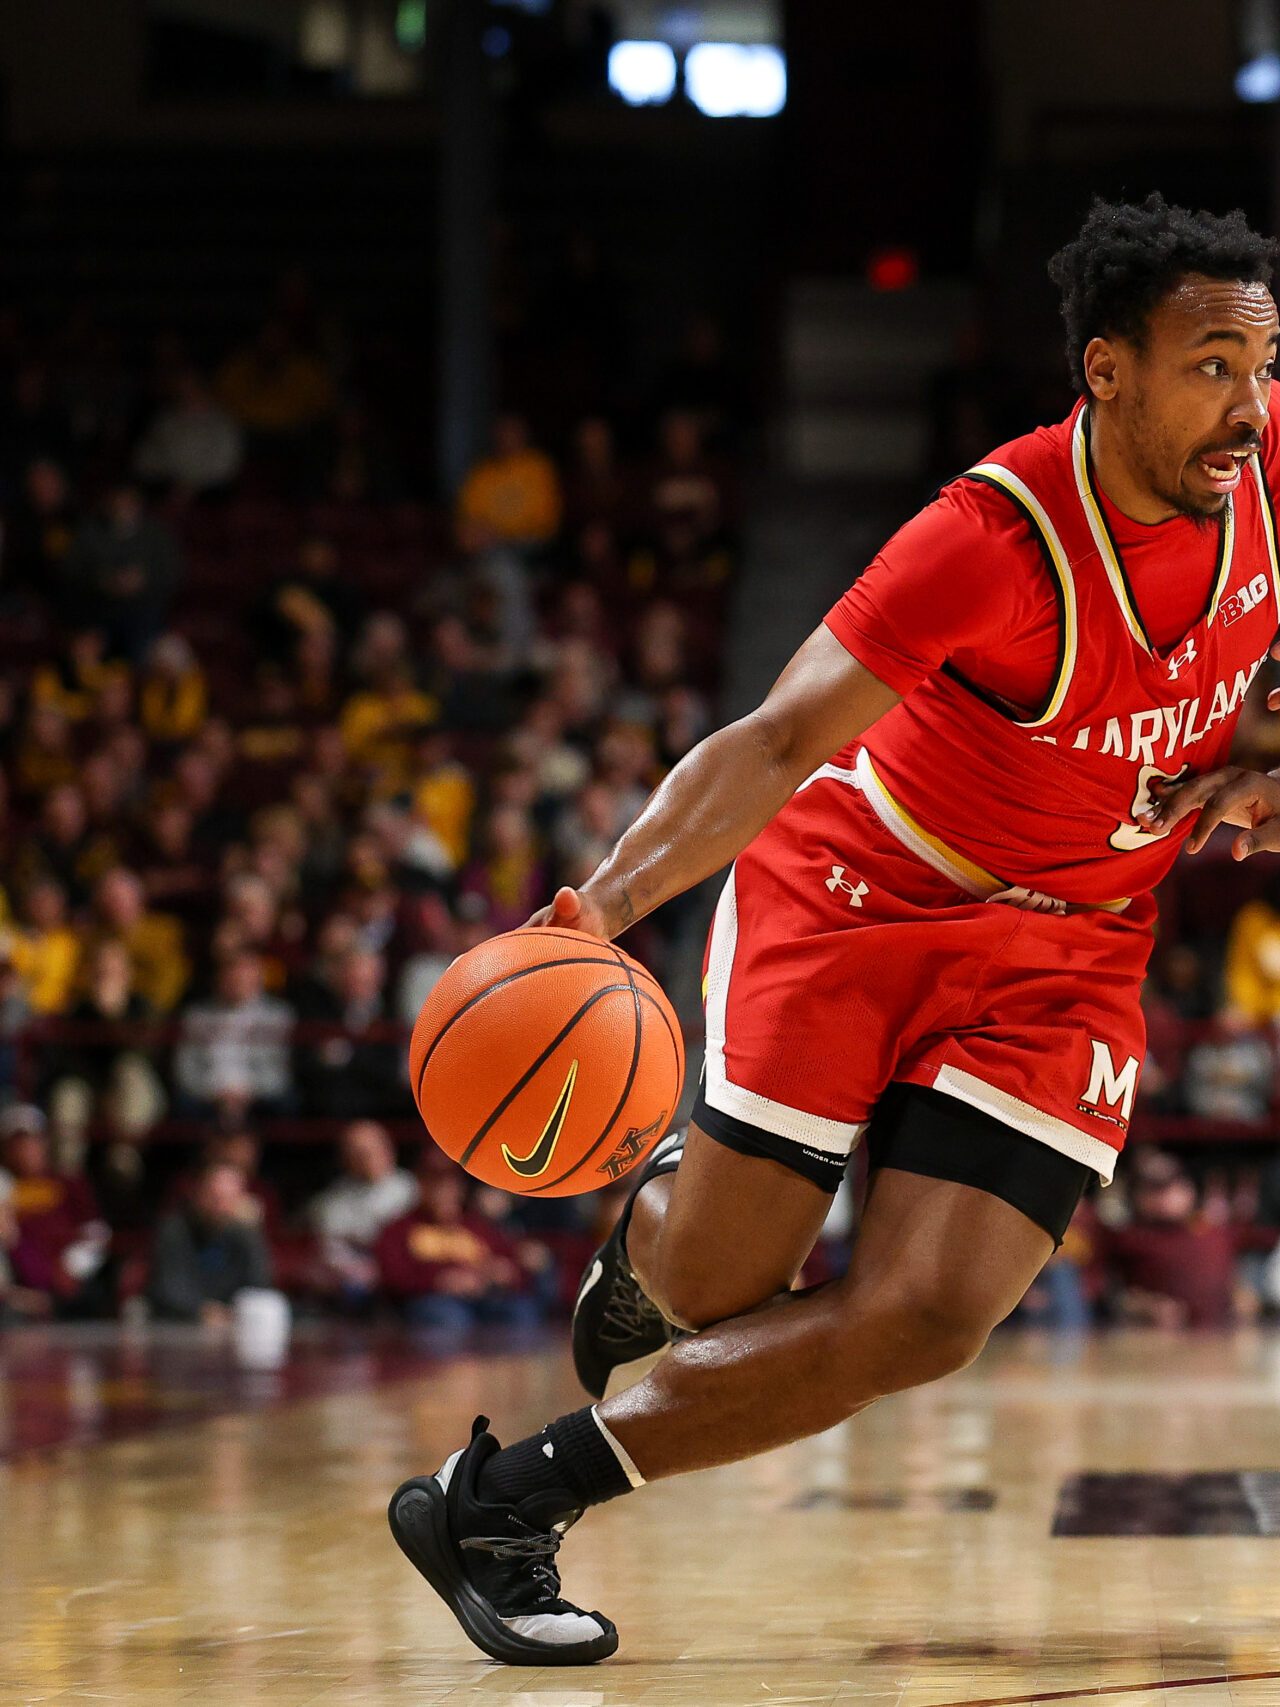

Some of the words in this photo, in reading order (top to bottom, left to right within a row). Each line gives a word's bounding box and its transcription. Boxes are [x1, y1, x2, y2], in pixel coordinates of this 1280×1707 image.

[1031, 647, 1269, 765] ARYLAN
[1079, 1038, 1140, 1122] M
[802, 1148, 829, 1163] UNDER
